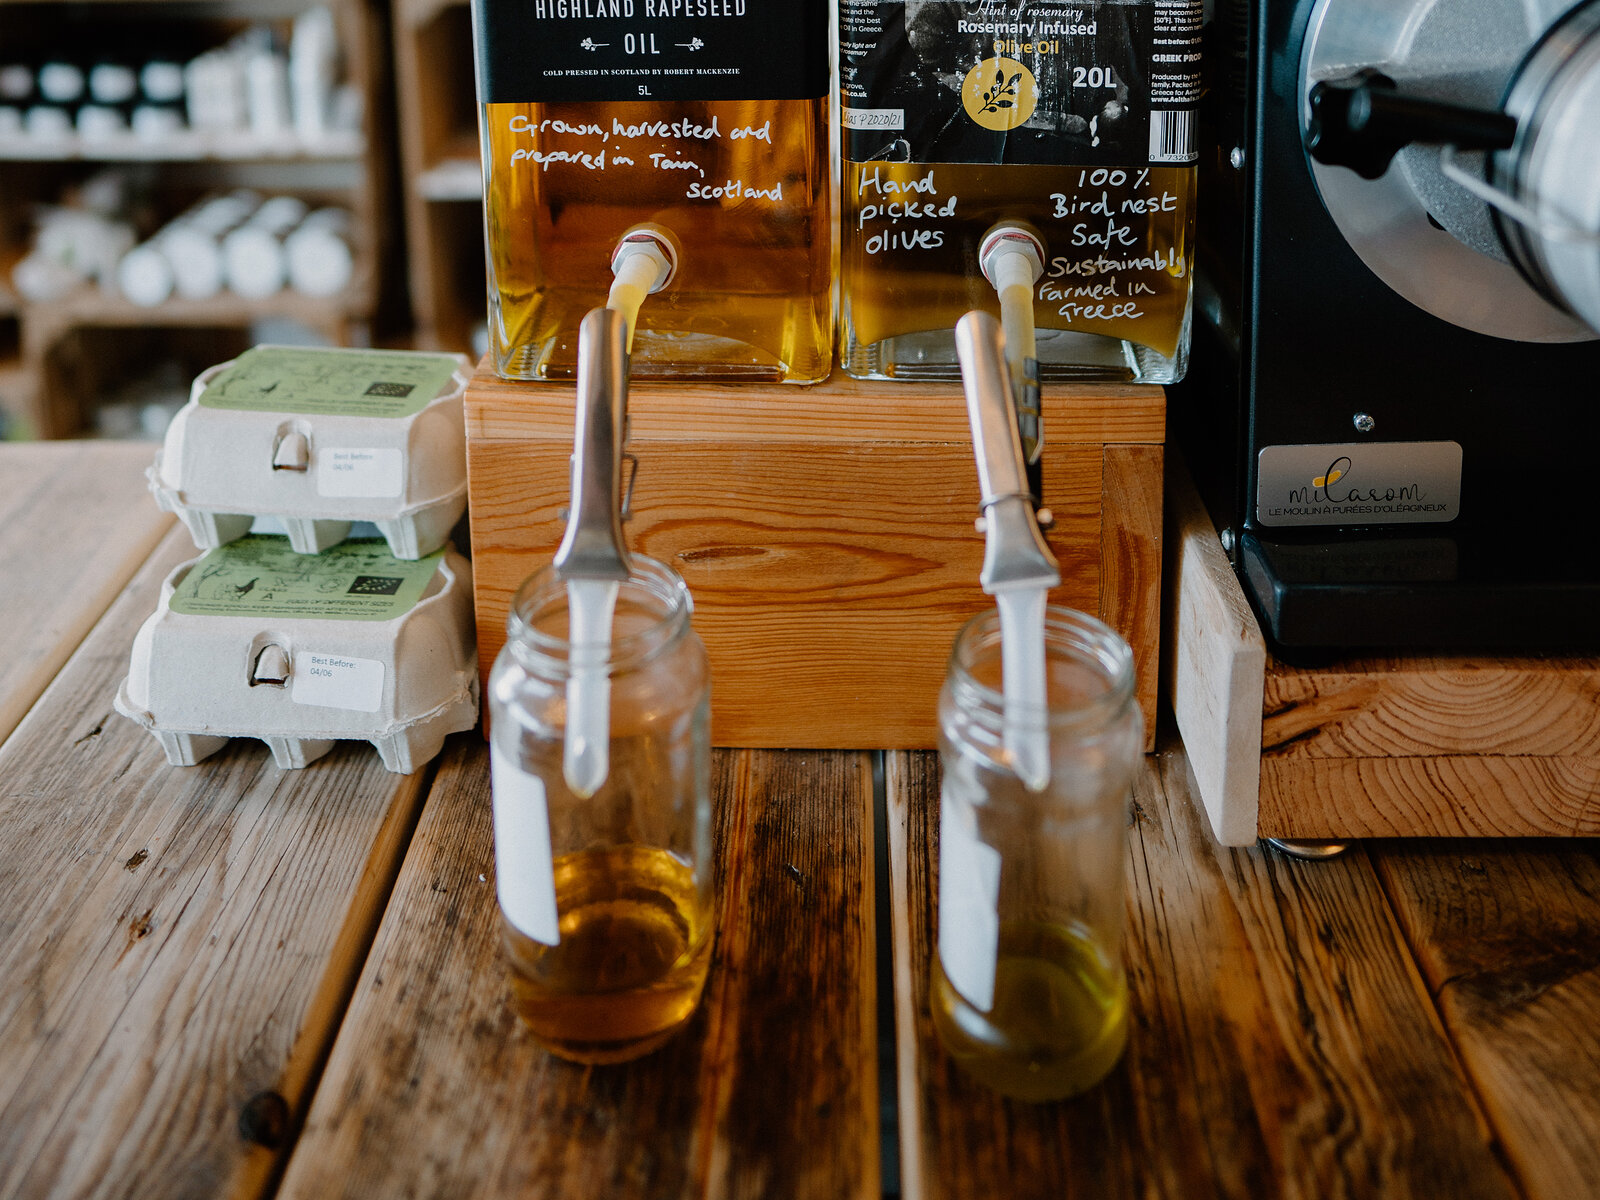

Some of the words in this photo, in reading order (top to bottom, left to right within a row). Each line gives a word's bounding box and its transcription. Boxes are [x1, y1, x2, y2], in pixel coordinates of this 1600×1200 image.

[535, 0, 634, 19] HIGHLAND
[1027, 5, 1083, 22] rosemary
[1154, 9, 1168, 17] may
[958, 19, 1034, 36] Rosemary
[1039, 20, 1097, 35] Infused
[624, 33, 660, 54] OIL
[993, 40, 1032, 54] Olive
[1037, 40, 1059, 54] Oil
[1152, 53, 1182, 62] GREEK
[1072, 66, 1117, 88] 20L
[1151, 81, 1171, 89] family.
[638, 85, 652, 96] 5L
[612, 115, 721, 139] harvested
[730, 120, 772, 144] and
[510, 148, 605, 172] prepared
[612, 146, 634, 166] in
[858, 166, 937, 196] Hand
[860, 195, 958, 230] picked
[1050, 191, 1115, 218] Bird
[1121, 191, 1178, 215] nest
[865, 220, 945, 255] olives
[1070, 218, 1138, 250] Safe
[1047, 247, 1186, 278] Sustainably
[1058, 302, 1144, 322] Greece
[1289, 457, 1427, 505] milarom
[1269, 508, 1281, 516] LE
[1284, 507, 1321, 515] MOULIN
[1323, 505, 1330, 514] À
[1332, 504, 1372, 514] PURÉES
[1374, 503, 1446, 512] D'OLÉAGINEUX
[310, 667, 333, 677] 04/06
[311, 656, 328, 665] Best
[329, 658, 356, 668] Before:
